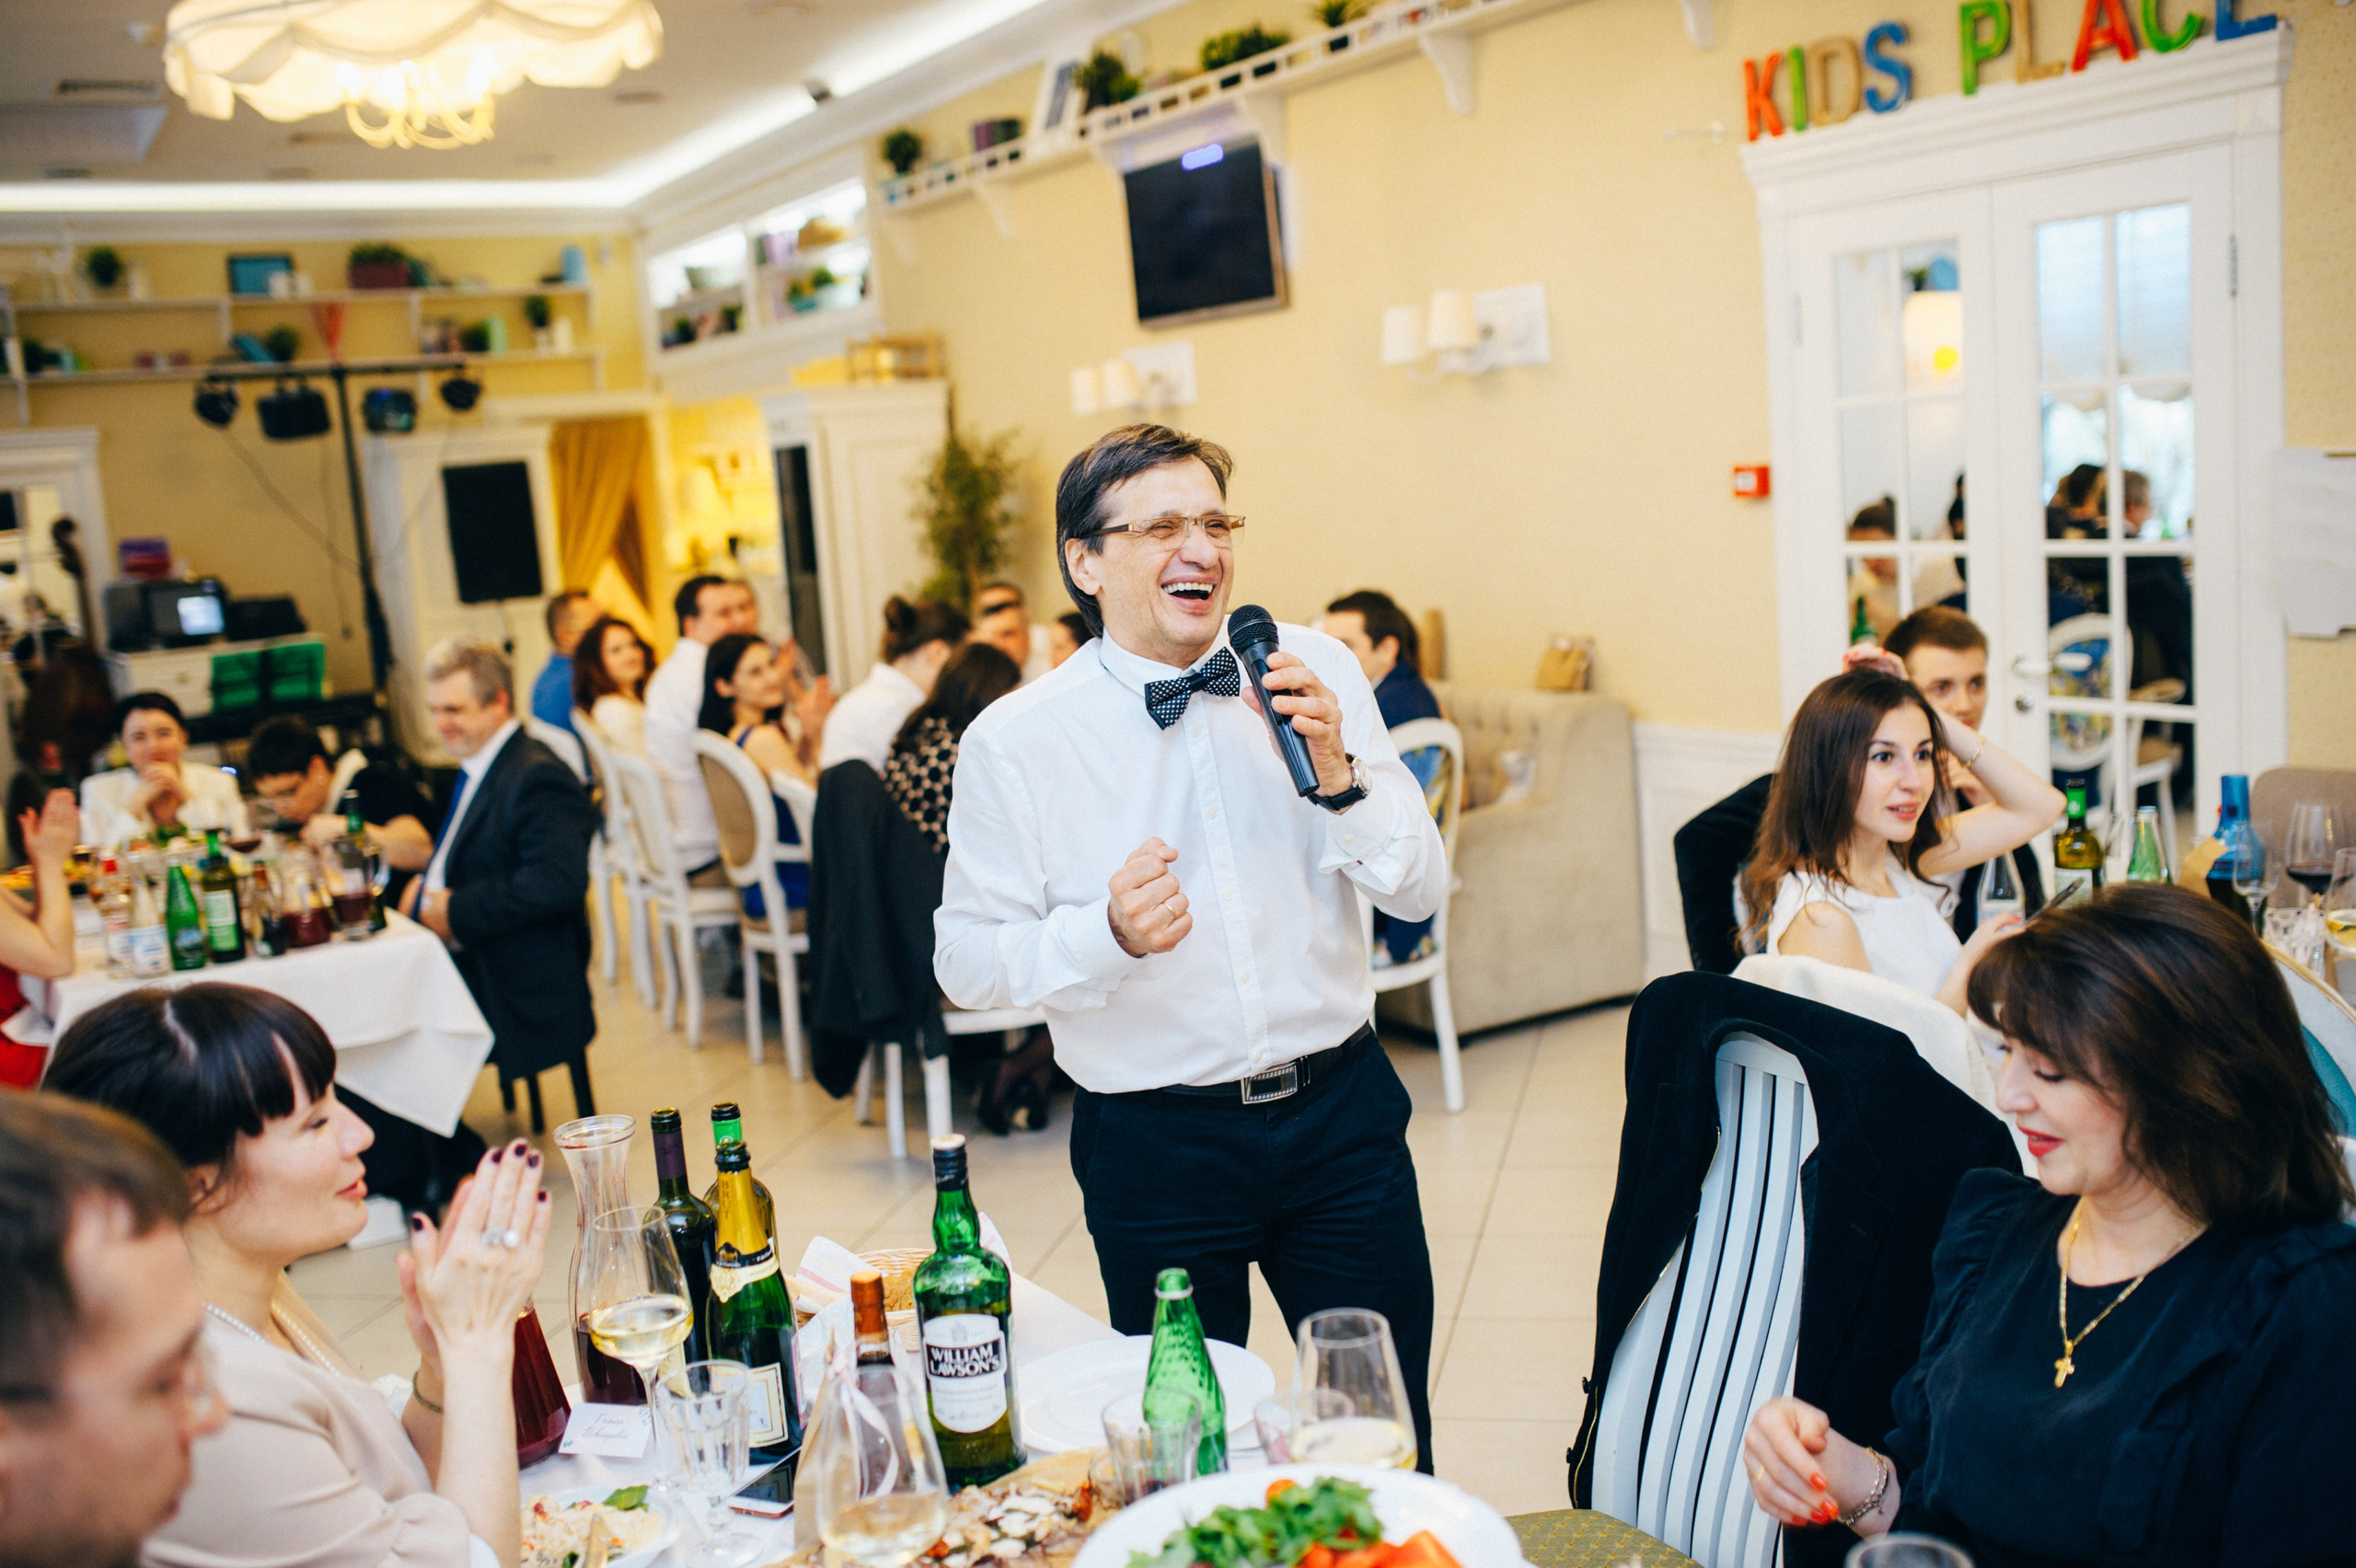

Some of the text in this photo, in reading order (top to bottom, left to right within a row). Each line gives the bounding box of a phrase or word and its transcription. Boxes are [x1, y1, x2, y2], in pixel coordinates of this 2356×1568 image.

[1744, 21, 1911, 142] KIDS
[721, 1180, 732, 1220] BRUT
[930, 1343, 994, 1363] WILLIAM
[930, 1355, 1000, 1377] LAWSON'S
